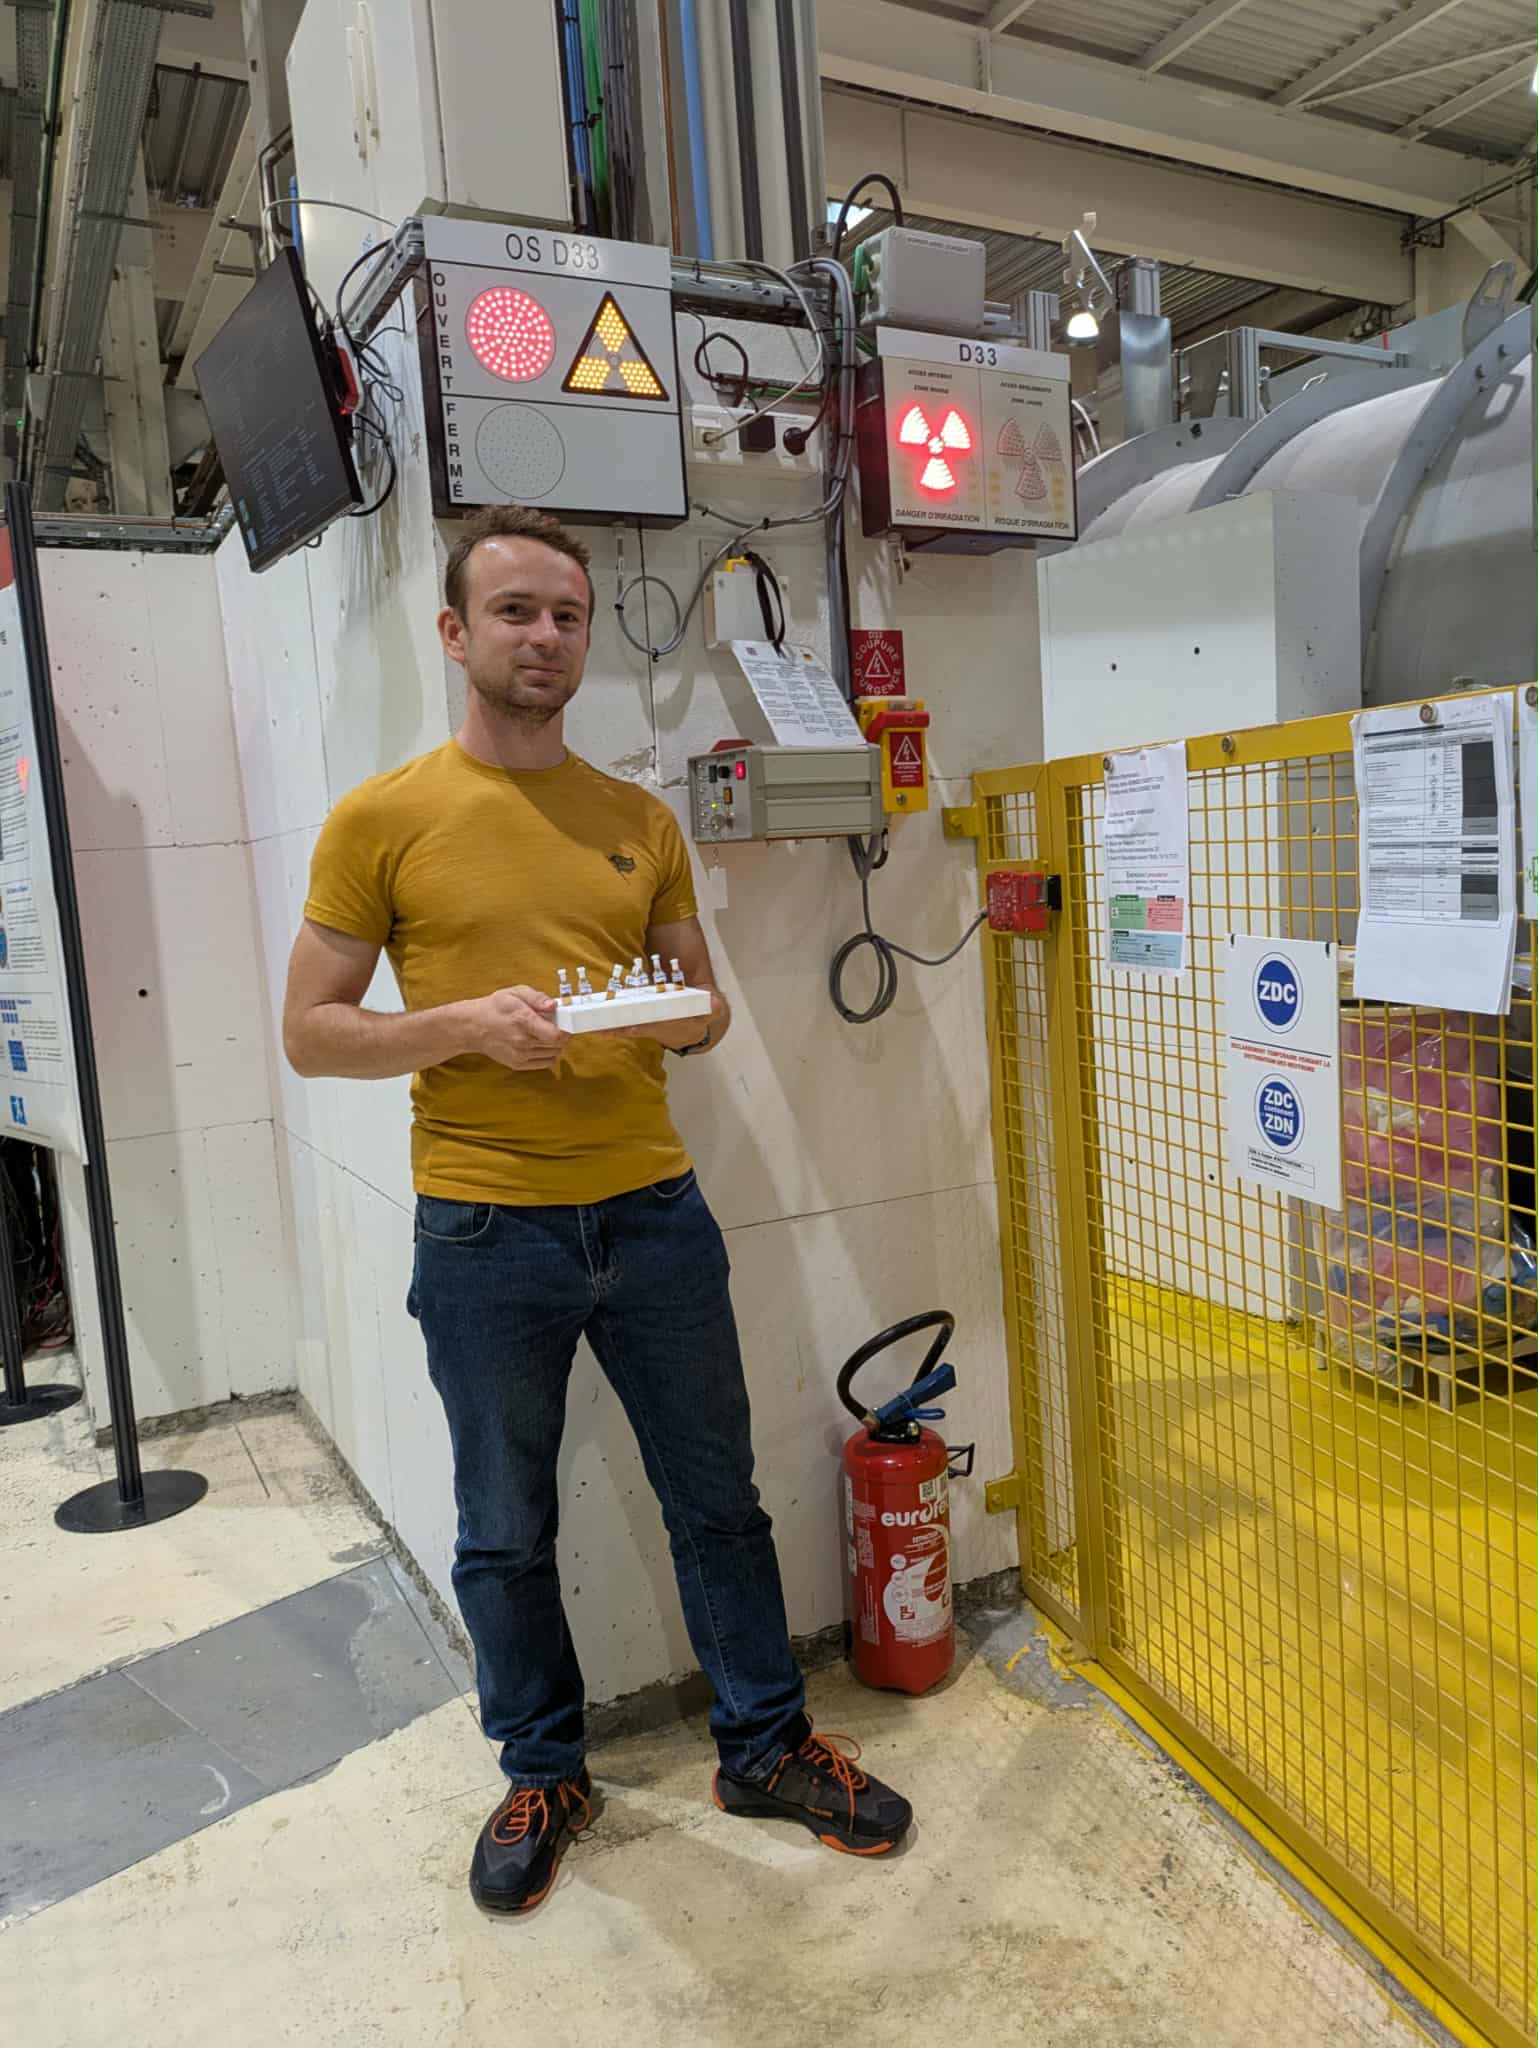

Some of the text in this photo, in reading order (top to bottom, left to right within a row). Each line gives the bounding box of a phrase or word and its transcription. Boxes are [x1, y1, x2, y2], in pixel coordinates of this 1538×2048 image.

[505, 233, 600, 270] OS D33
[433, 272, 455, 389] OUVERT
[959, 343, 998, 366] D33
[895, 508, 980, 524] DANGER D'IRRADIATION
[994, 515, 1019, 527] RISQUE
[855, 639, 899, 662] COUPURE
[854, 667, 901, 695] D'URGENCE
[1258, 979, 1296, 1005] ZDC
[1264, 1087, 1294, 1109] ZDC
[1264, 1112, 1294, 1136] ZDN
